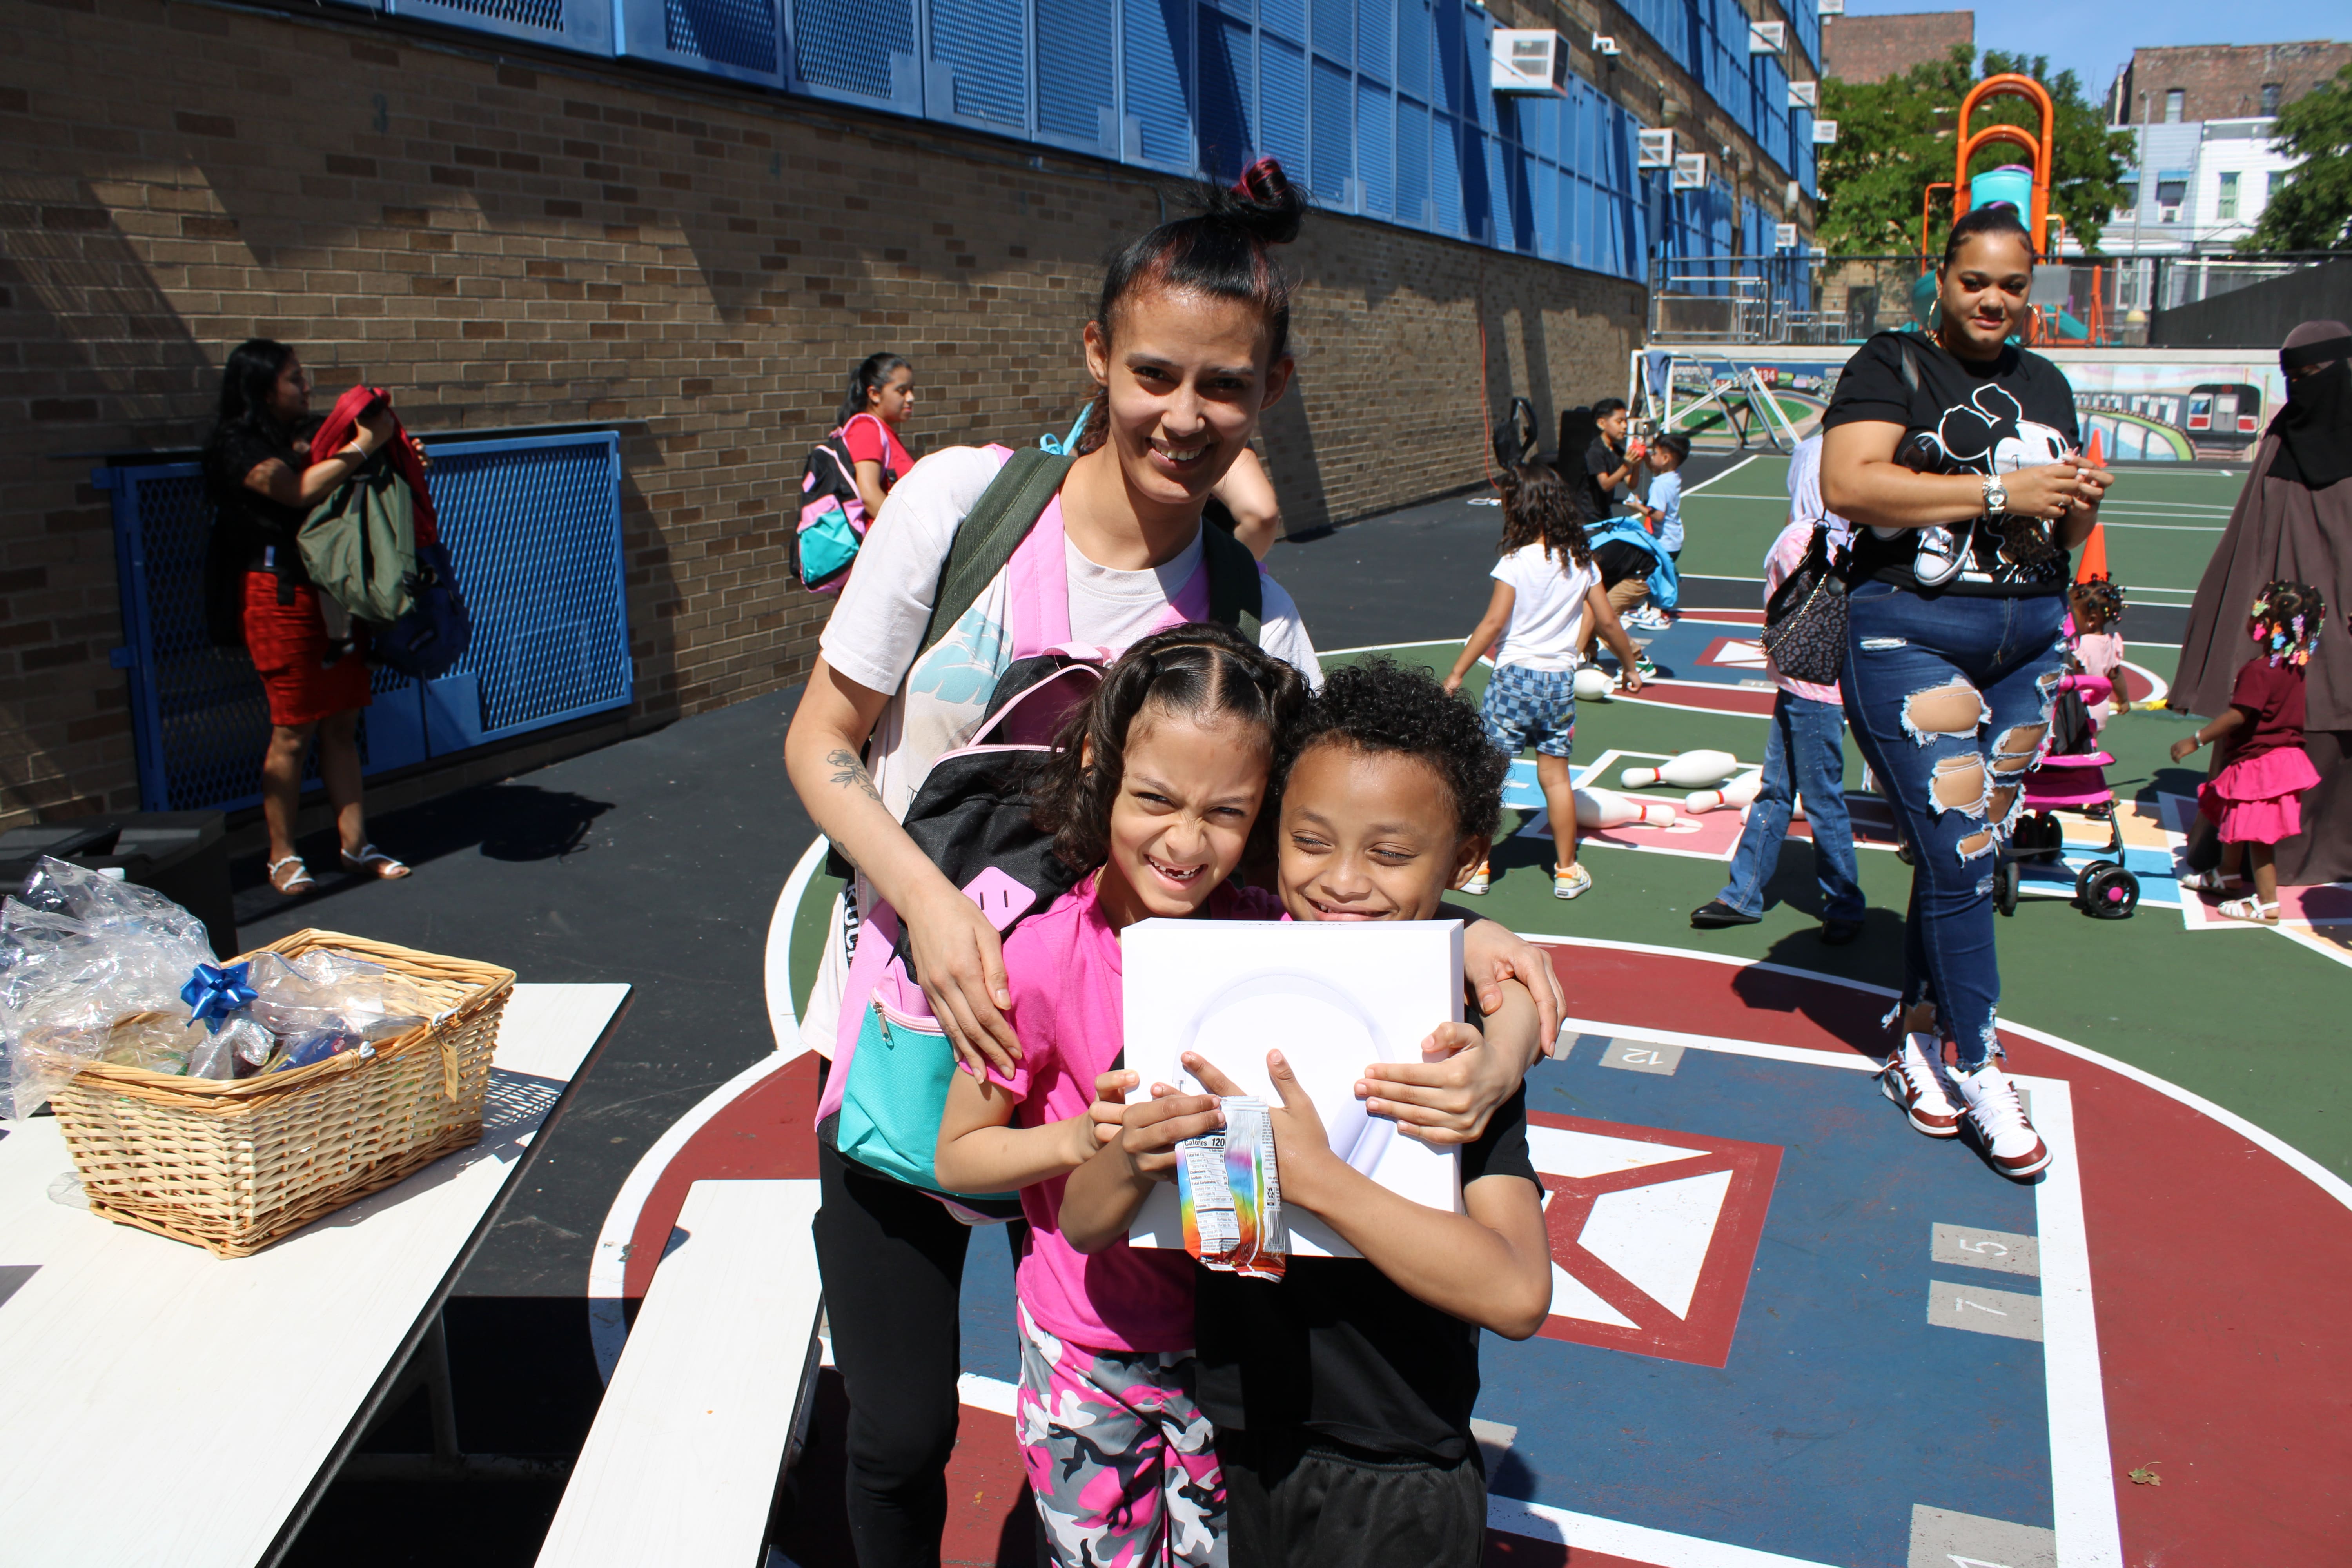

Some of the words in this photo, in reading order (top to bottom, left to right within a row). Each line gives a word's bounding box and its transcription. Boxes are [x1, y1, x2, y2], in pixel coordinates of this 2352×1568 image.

[1622, 1048, 1663, 1065] 12
[1212, 1138, 1225, 1146] 120
[1960, 1239, 2008, 1256] 5
[1956, 1298, 2007, 1316] 7
